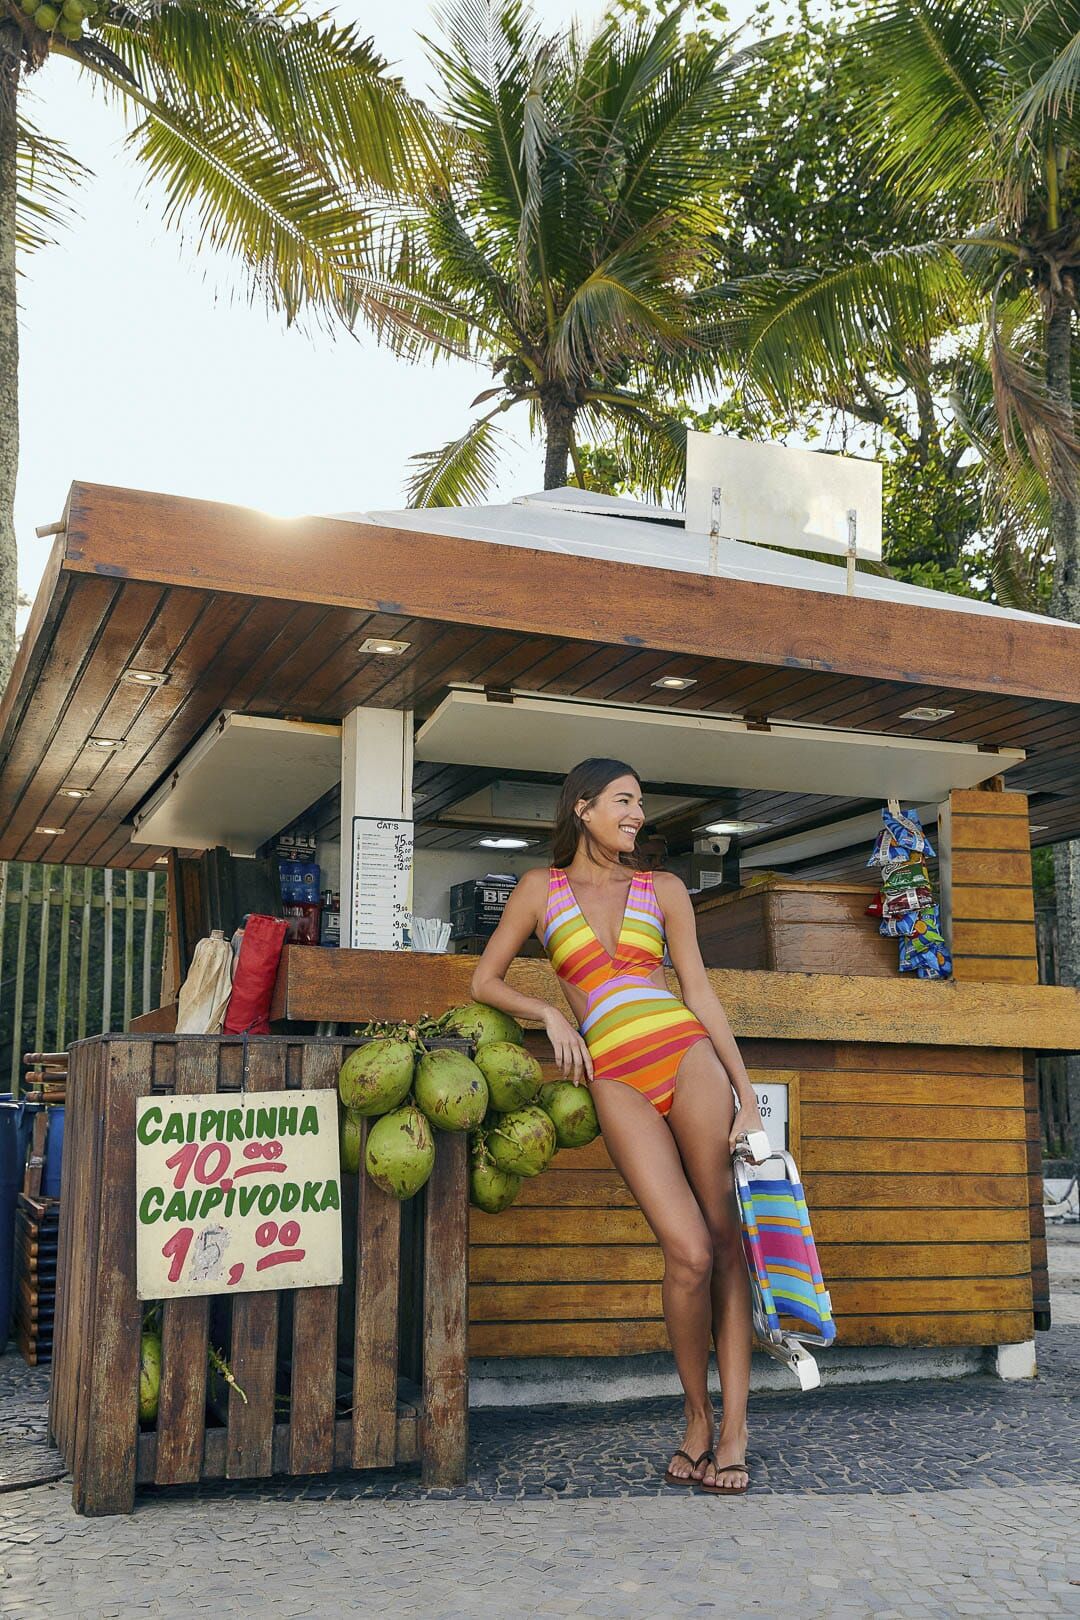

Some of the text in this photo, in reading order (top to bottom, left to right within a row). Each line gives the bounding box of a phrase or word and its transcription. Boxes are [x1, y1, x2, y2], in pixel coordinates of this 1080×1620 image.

[483, 889, 513, 903] BE
[758, 1106, 772, 1117] O?
[137, 1106, 319, 1146] CAIPIRINHA
[139, 1179, 340, 1225] CAIPIVODKA
